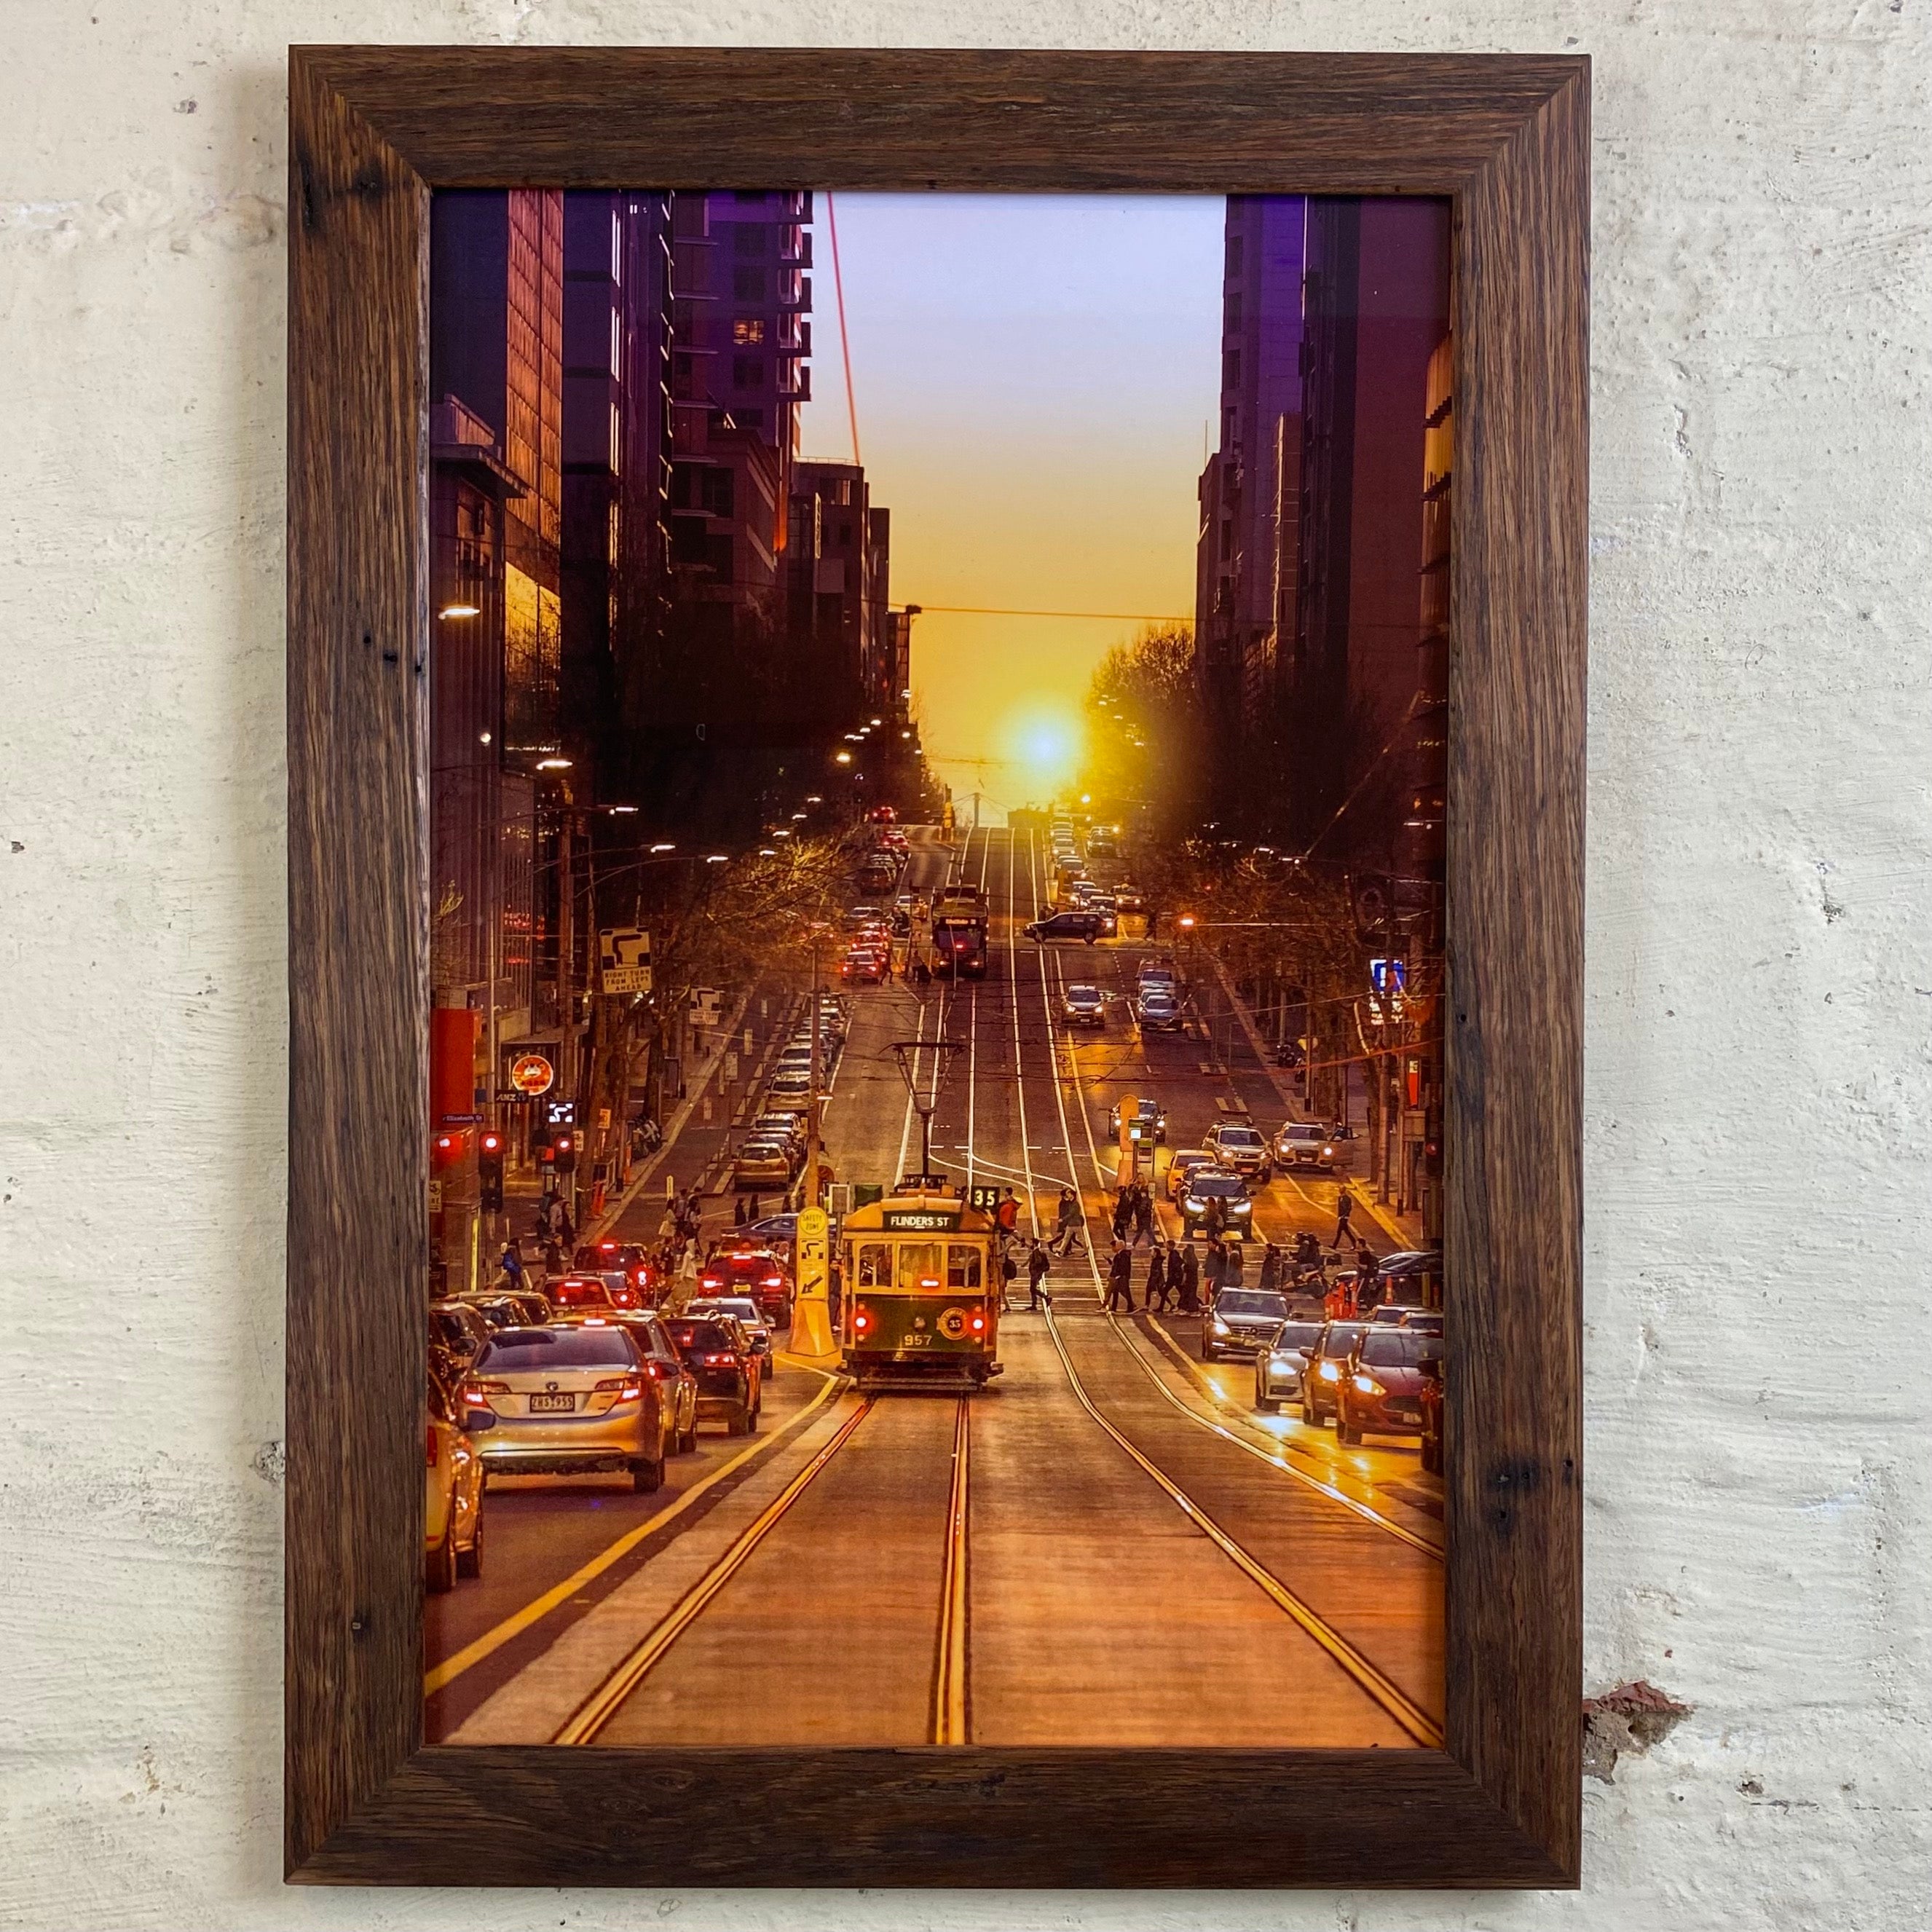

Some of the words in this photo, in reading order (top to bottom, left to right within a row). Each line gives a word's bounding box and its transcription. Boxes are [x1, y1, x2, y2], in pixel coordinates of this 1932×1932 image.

[615, 983, 642, 991] AHEAD
[974, 1189, 995, 1206] 35
[891, 1216, 934, 1226] FLINDERS
[937, 1217, 950, 1226] ST
[949, 1320, 961, 1328] 35
[904, 1335, 932, 1346] 957
